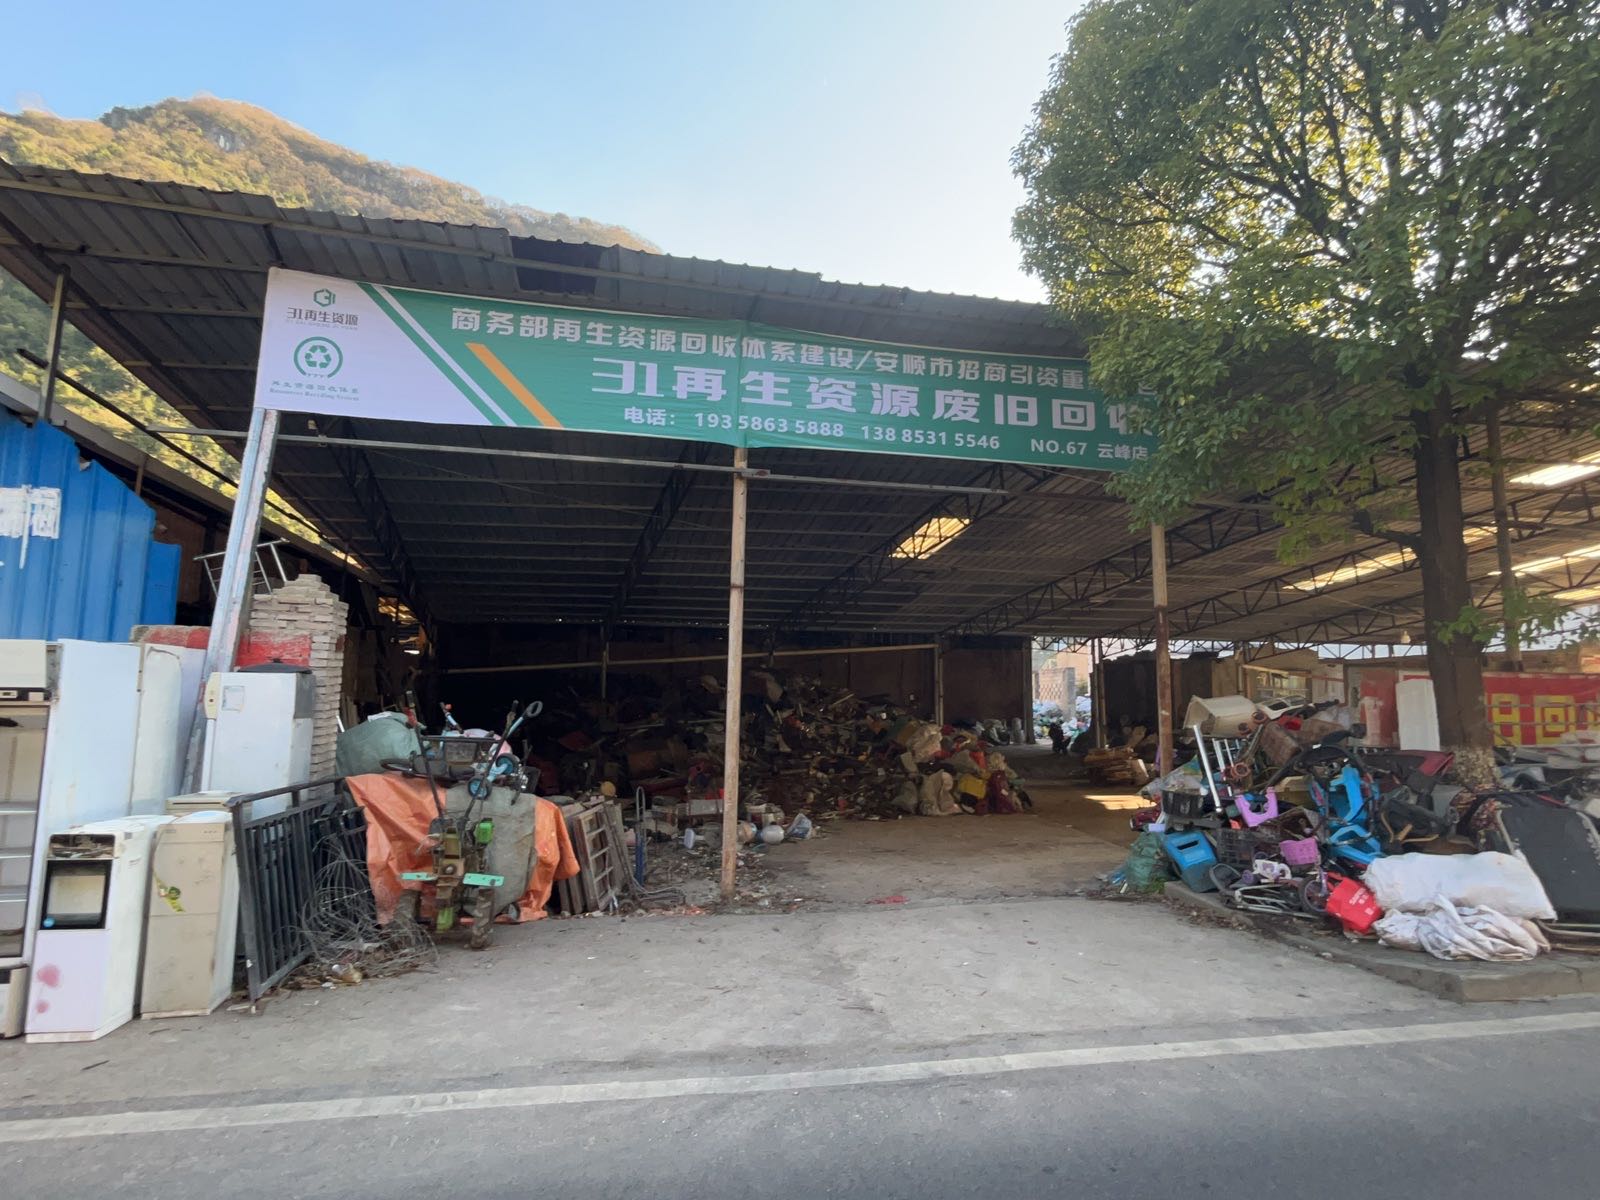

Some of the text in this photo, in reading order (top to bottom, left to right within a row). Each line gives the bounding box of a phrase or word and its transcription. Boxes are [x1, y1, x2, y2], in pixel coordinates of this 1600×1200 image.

[451, 307, 1158, 395] 商务部再生资源回收体系建设/安顺市招商引资重
[695, 413, 732, 430] 193
[738, 415, 788, 433] 5863
[795, 420, 844, 437] 5888
[861, 425, 896, 442] 138
[901, 428, 947, 446] 8531
[954, 433, 1000, 449] 5546
[1031, 439, 1088, 455] NO.67
